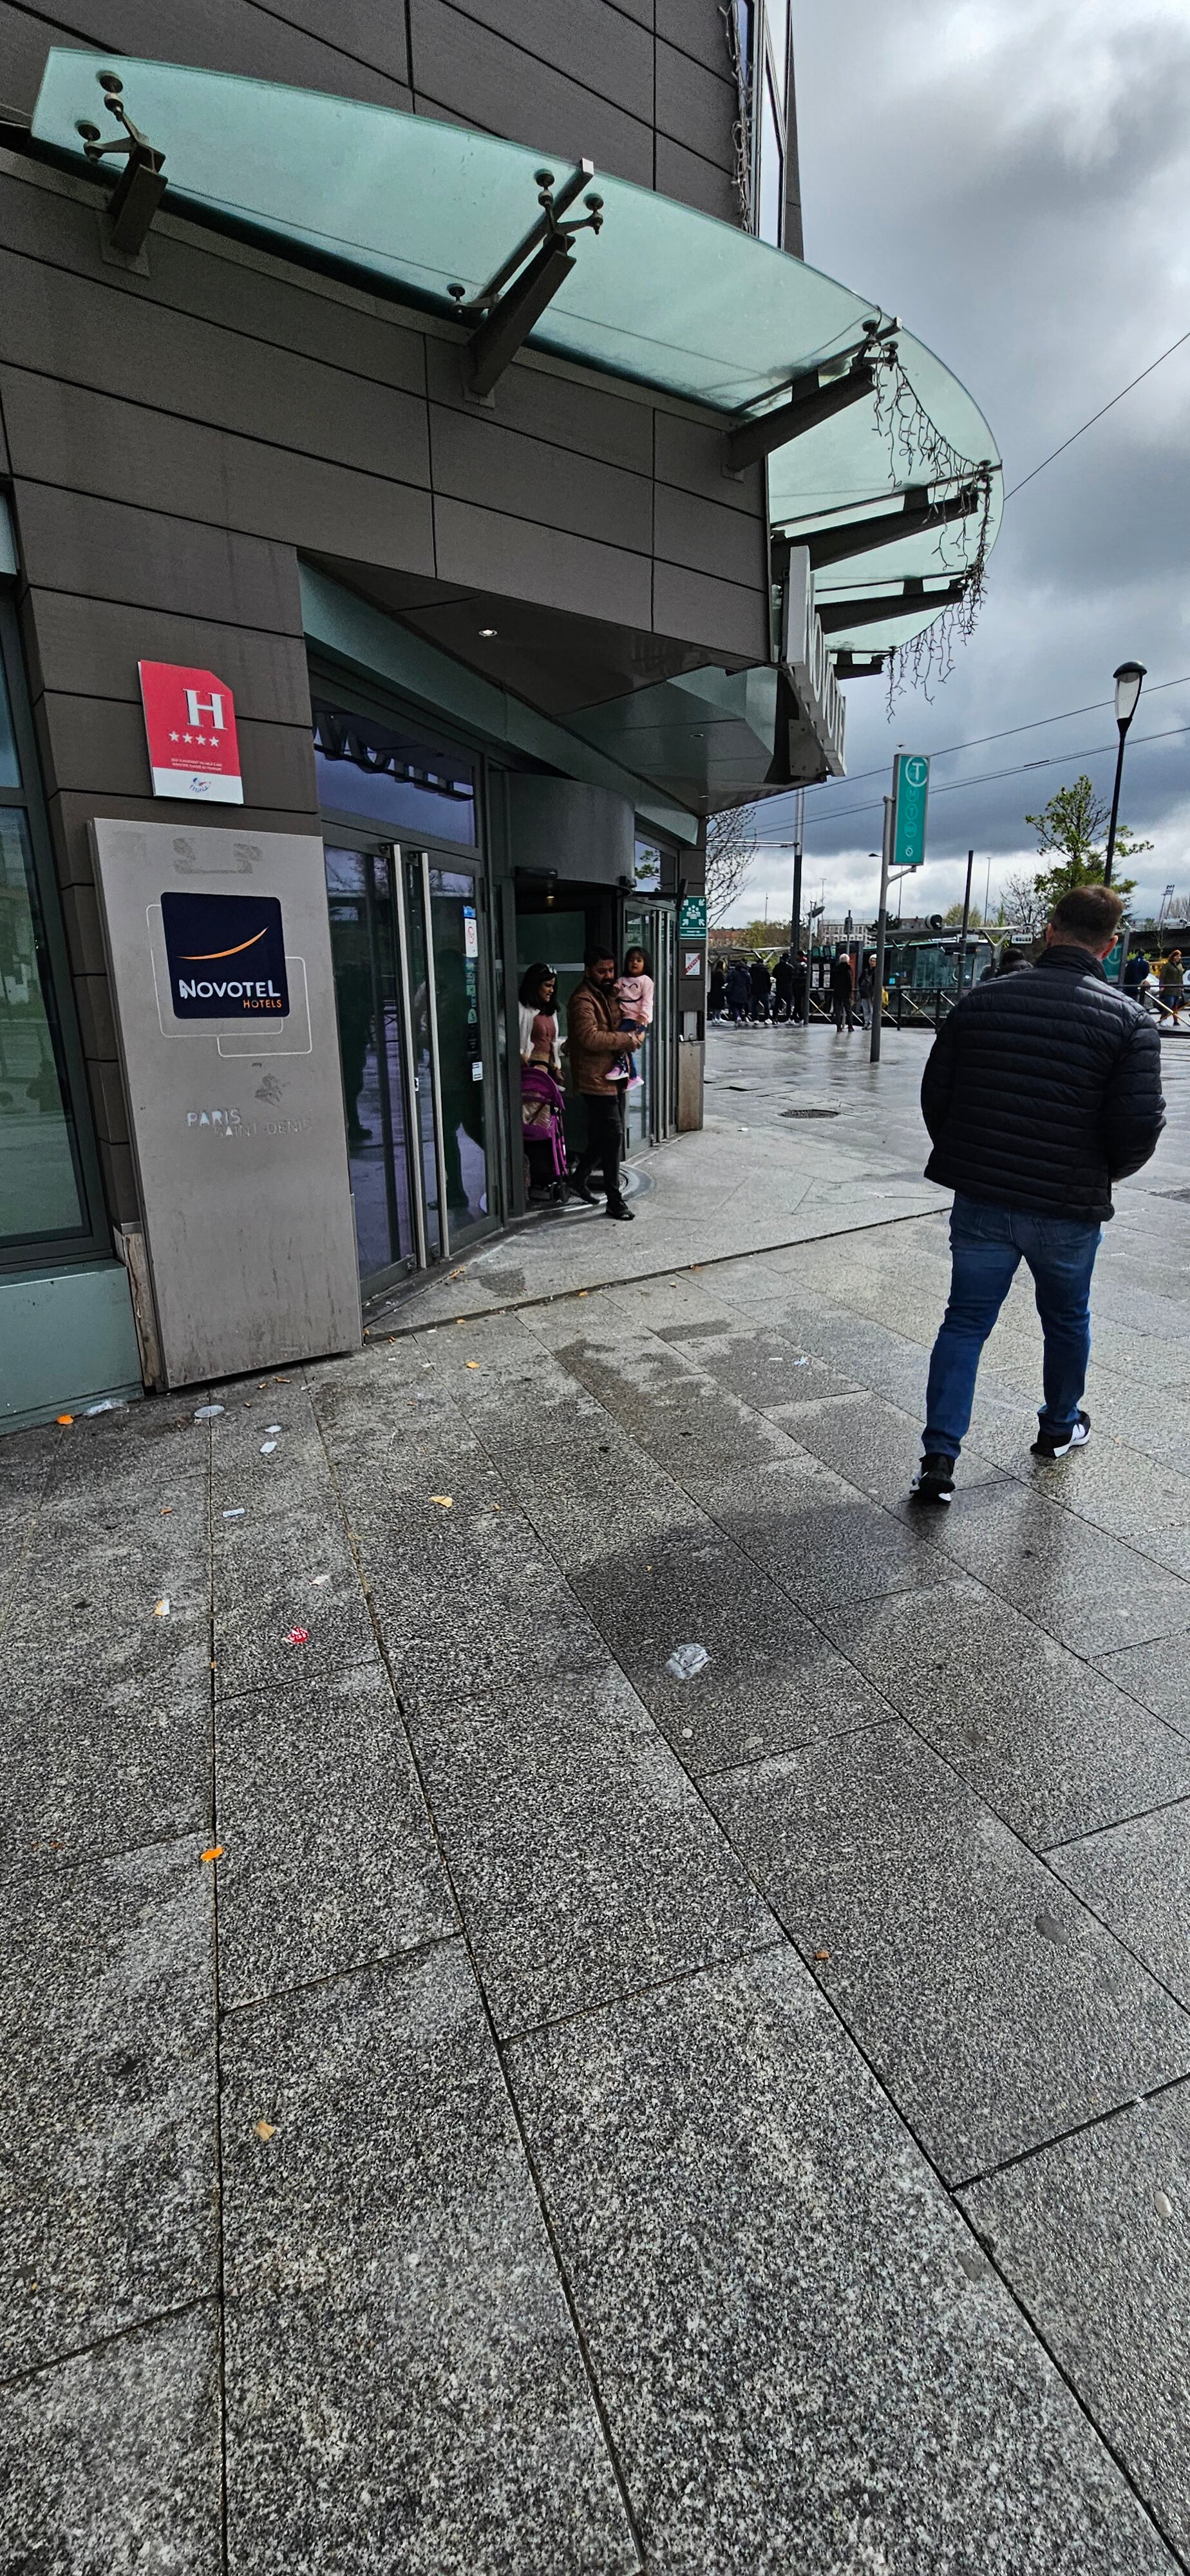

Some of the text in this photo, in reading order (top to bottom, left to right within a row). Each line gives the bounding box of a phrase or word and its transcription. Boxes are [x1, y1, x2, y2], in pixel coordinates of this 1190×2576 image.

[183, 688, 228, 730] H
[178, 979, 281, 999] NOVOTEL
[243, 999, 282, 1009] HOTELS
[187, 1108, 241, 1128] PARIS
